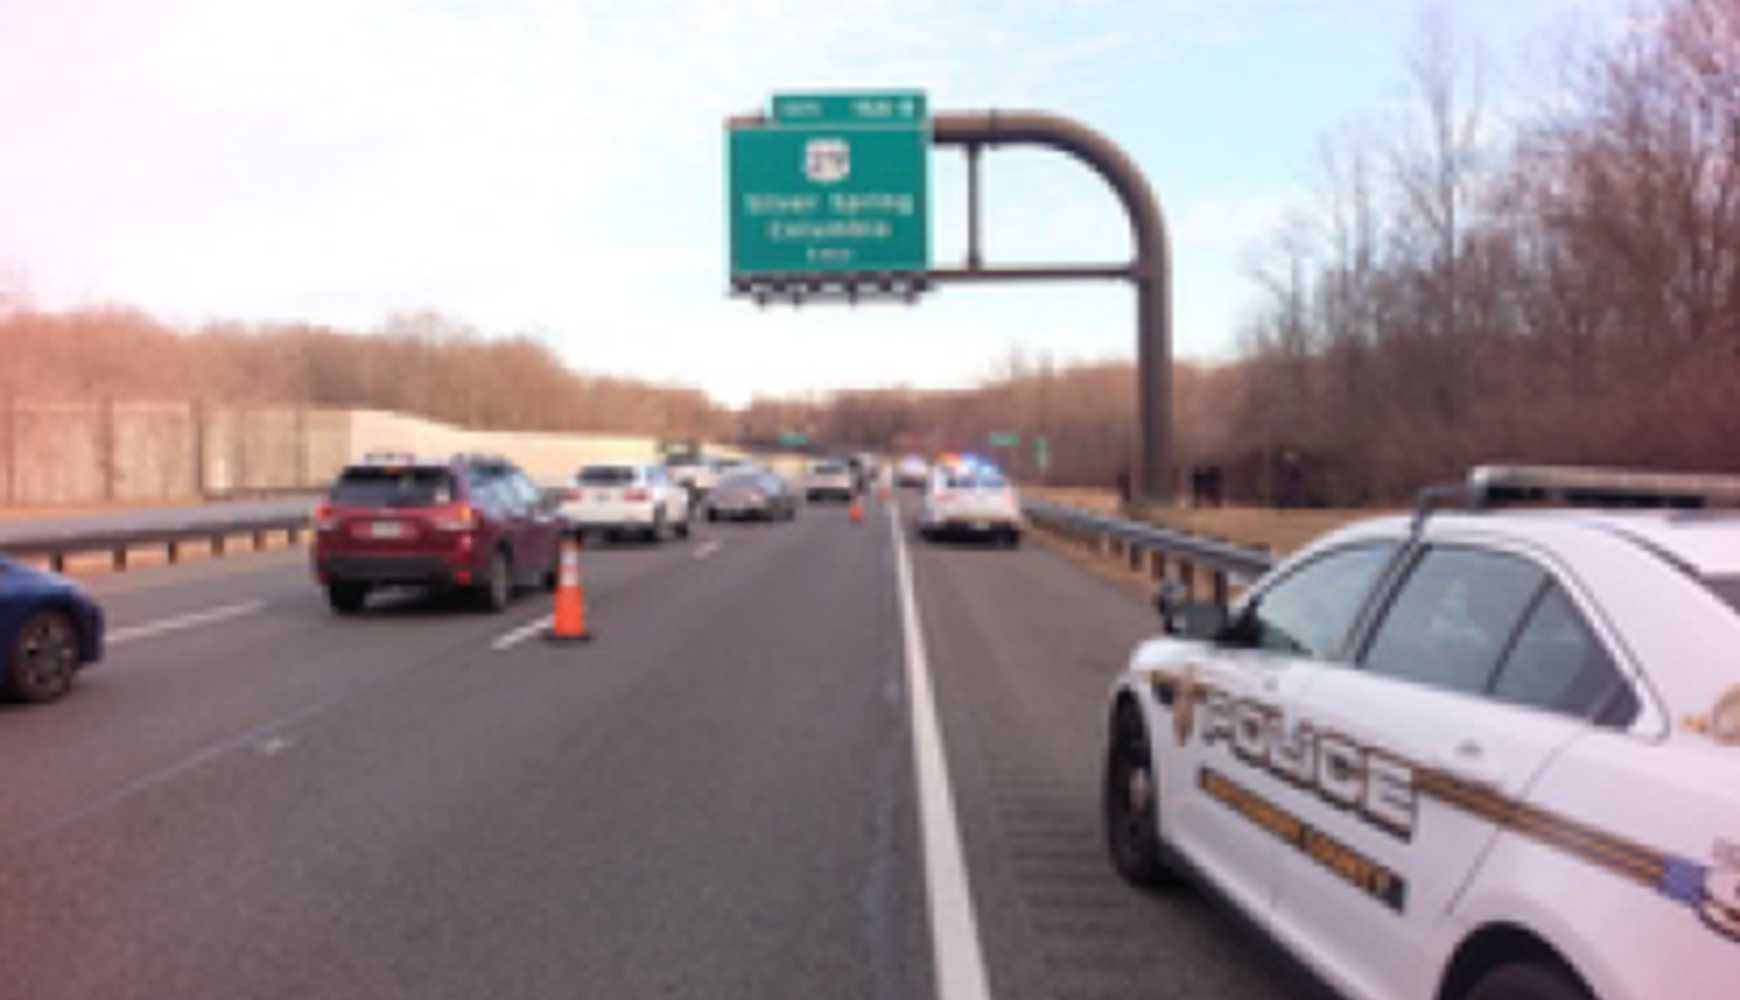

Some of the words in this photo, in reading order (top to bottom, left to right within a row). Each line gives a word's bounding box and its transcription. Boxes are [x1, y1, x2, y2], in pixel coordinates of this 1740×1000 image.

[745, 193, 818, 214] Silver
[830, 193, 914, 215] Spring
[769, 220, 891, 240] Columbia
[1201, 689, 1417, 843] POLICE
